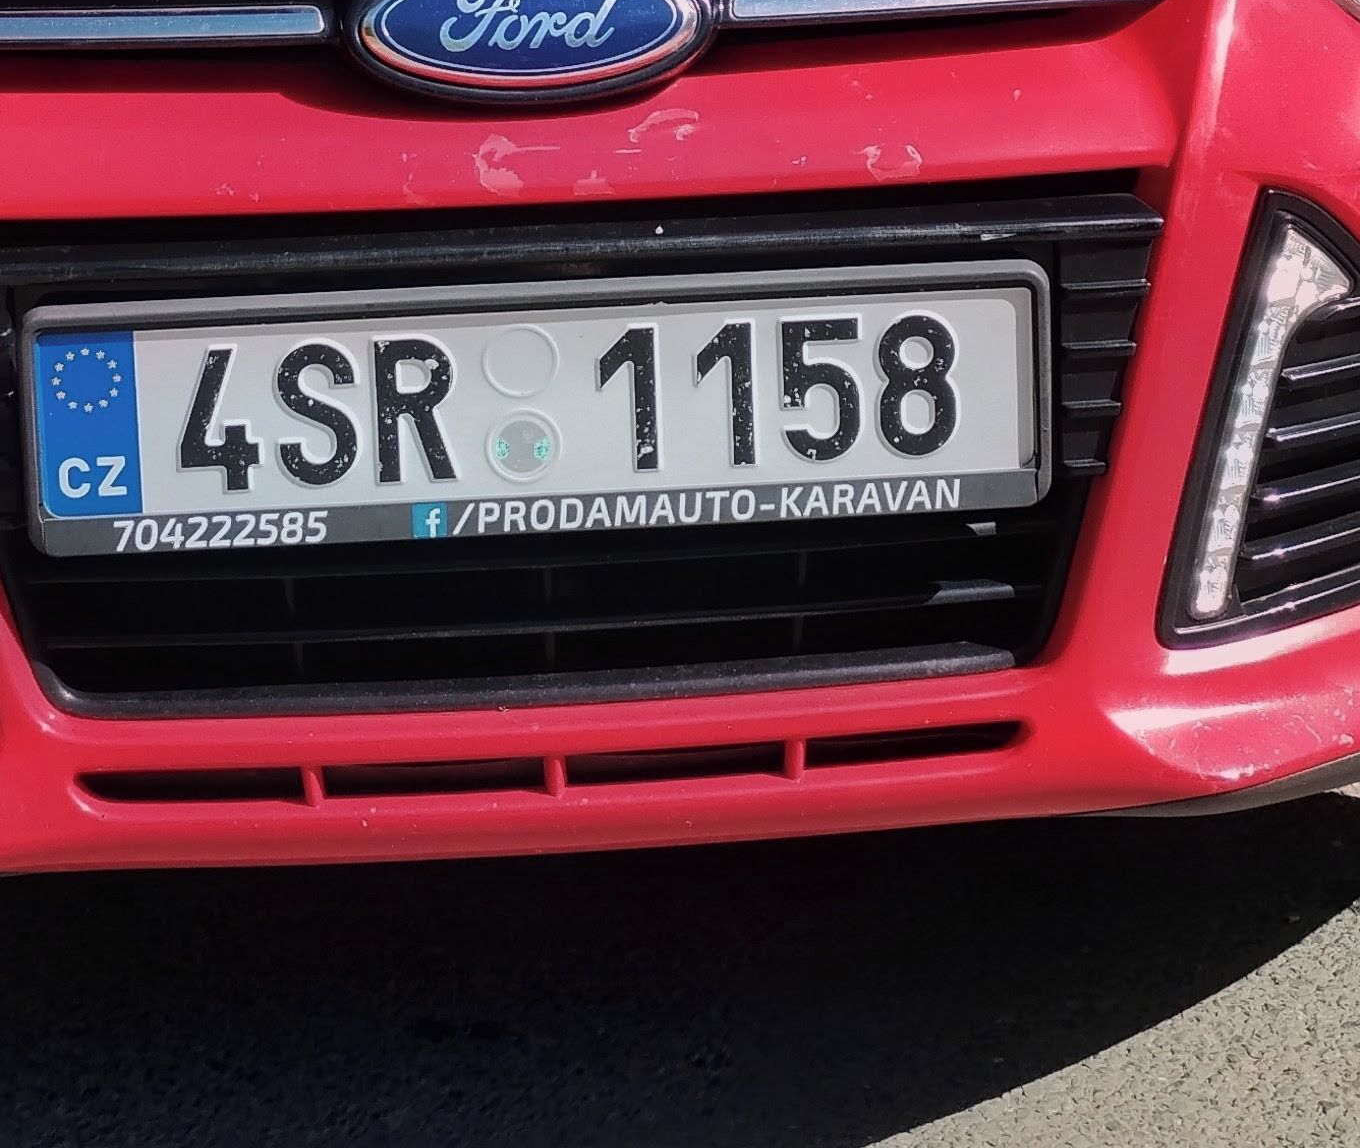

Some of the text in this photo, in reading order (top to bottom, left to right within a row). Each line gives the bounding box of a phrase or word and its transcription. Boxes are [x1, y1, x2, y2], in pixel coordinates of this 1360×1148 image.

[179, 314, 957, 491] 4SR 1158
[58, 455, 128, 500] CZ
[112, 509, 329, 553] 704222585
